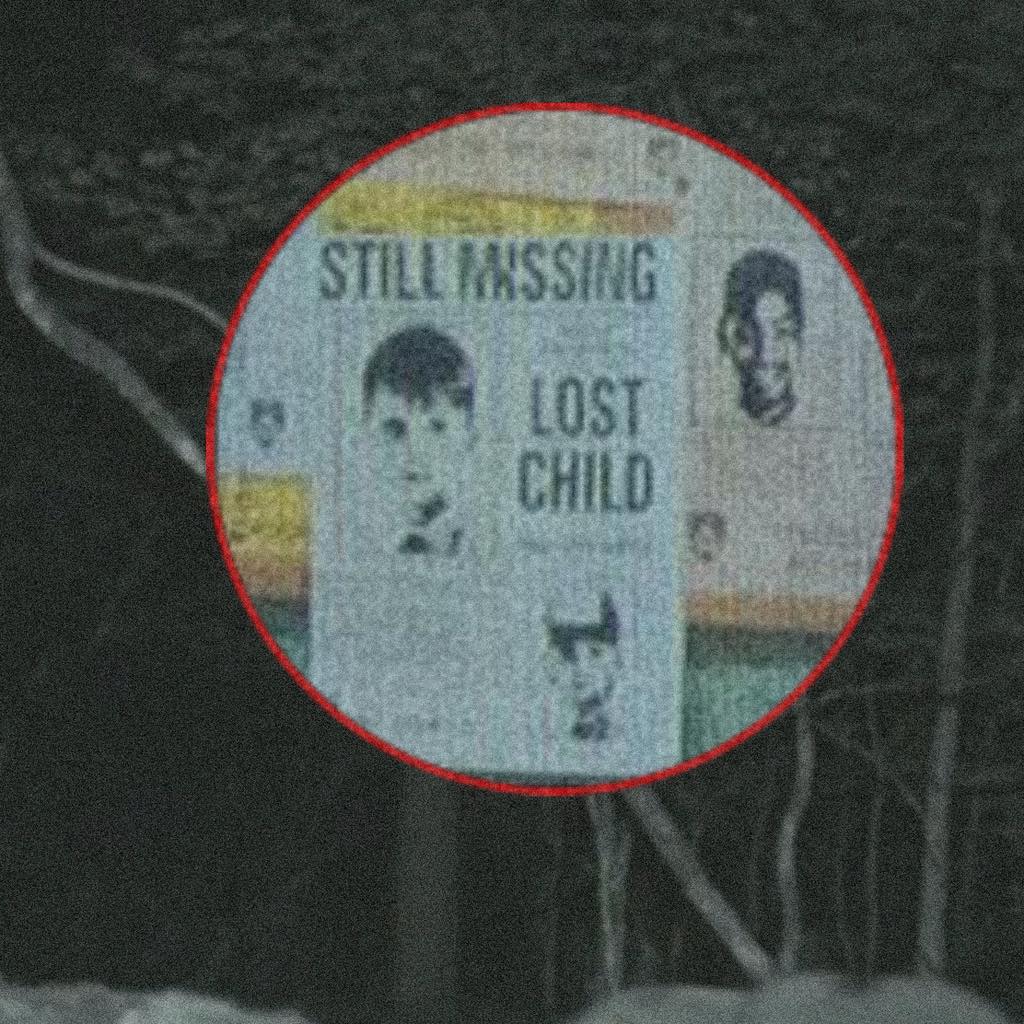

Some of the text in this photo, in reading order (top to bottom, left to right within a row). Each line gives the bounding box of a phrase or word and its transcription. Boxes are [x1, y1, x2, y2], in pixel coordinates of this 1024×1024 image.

[320, 238, 657, 303] STILL MISSING
[531, 375, 644, 438] LOST
[518, 452, 653, 512] CHILD
